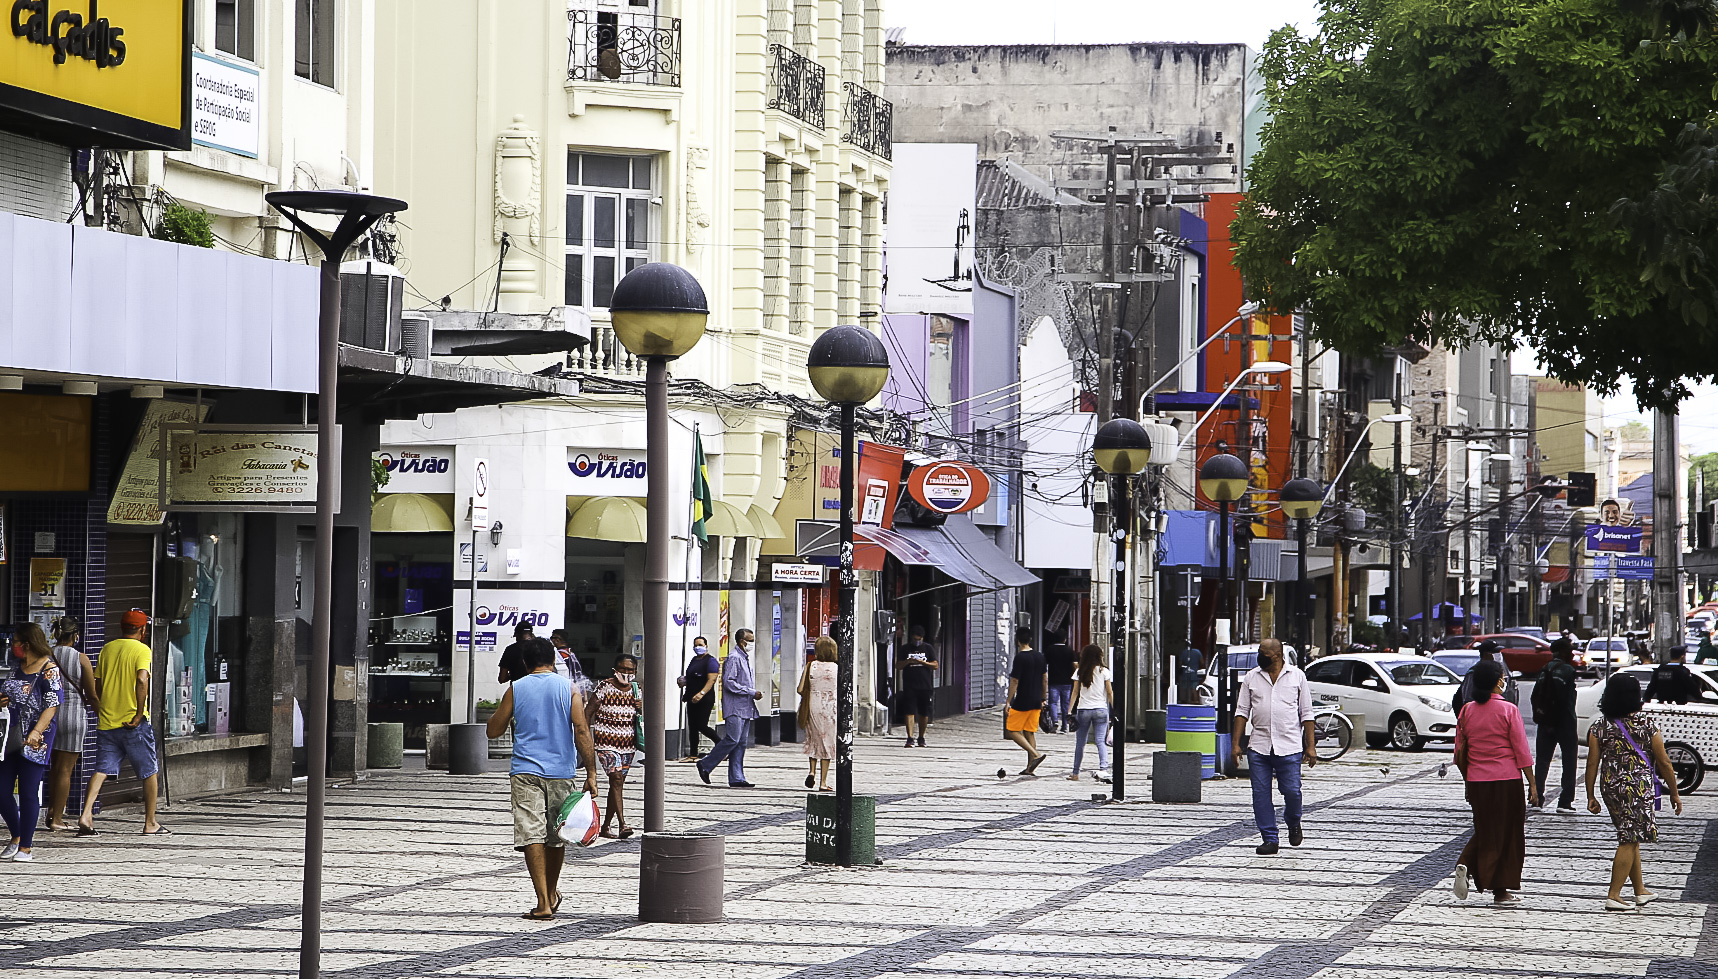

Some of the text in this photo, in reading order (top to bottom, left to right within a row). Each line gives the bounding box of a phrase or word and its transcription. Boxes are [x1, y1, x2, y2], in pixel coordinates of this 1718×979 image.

[195, 72, 255, 104] Coordenadoria Especial
[195, 93, 251, 123] de Participação Social
[194, 120, 199, 133] e
[230, 442, 257, 451] das
[260, 441, 318, 459] Canetas
[400, 450, 421, 459] Óticas
[597, 452, 619, 461] Óticas
[241, 458, 288, 470] Tabacaria
[398, 456, 450, 474] Visão
[595, 458, 647, 479] Visão
[208, 474, 242, 482] Artigos
[207, 480, 254, 488] Gravações
[227, 486, 303, 494] 3226.9480
[1604, 532, 1631, 540] brisanet
[1618, 558, 1640, 567] Travessa
[38, 583, 58, 597] 31
[498, 604, 519, 612] Óticas
